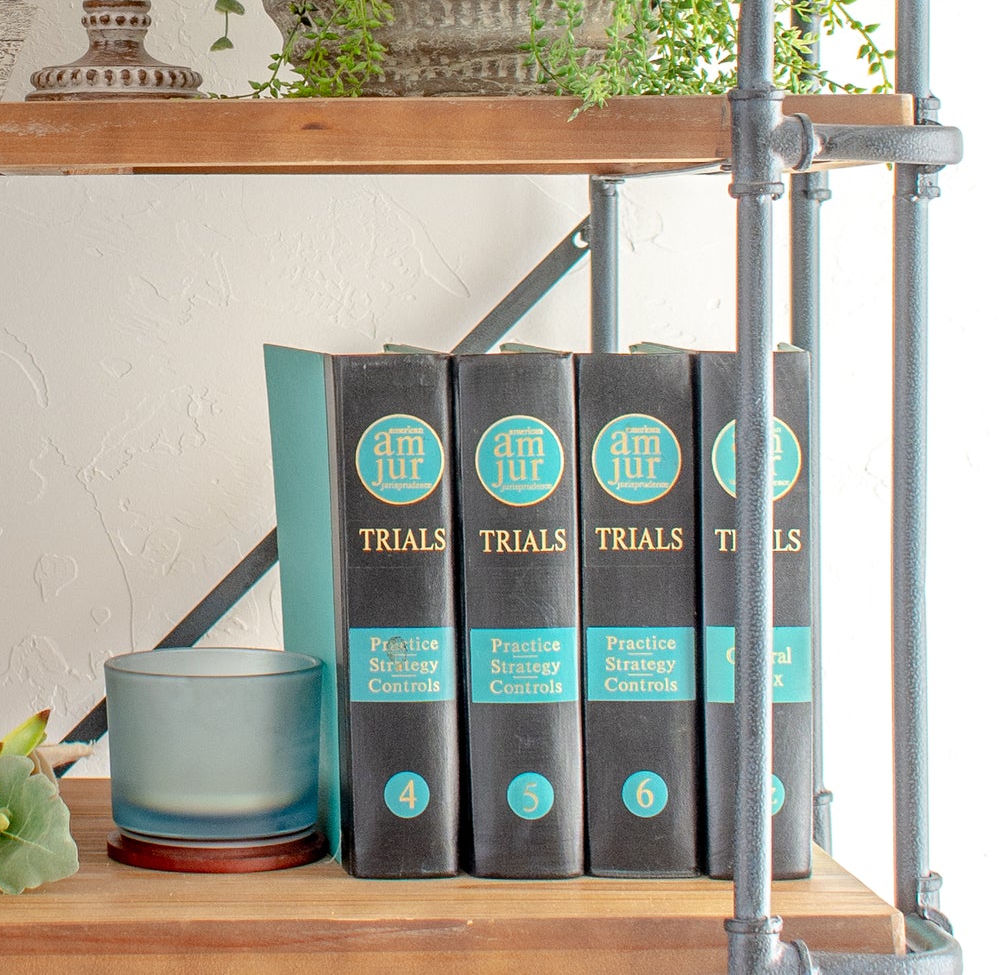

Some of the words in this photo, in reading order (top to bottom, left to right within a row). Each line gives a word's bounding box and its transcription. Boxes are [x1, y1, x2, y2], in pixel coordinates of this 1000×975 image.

[389, 425, 424, 434] american
[508, 426, 544, 435] american
[374, 431, 425, 456] am
[493, 432, 545, 457] am
[610, 431, 661, 456] am
[371, 457, 424, 486] jur
[491, 458, 544, 487] jur
[608, 456, 661, 485] jur
[380, 482, 432, 491] jurisprudence
[500, 483, 552, 492] jurisprudence
[616, 481, 669, 490] jurisprudence
[359, 528, 447, 552] TRIALS
[479, 529, 568, 553] TRIALS
[595, 527, 684, 551] TRIALS
[714, 528, 802, 552] TLS
[370, 636, 439, 652] Practice
[490, 638, 561, 654] Practice
[606, 636, 677, 650] Practice
[369, 657, 439, 674] Strategy
[490, 659, 561, 675] Strategy
[605, 657, 676, 673] Strategy
[368, 678, 441, 693] Controls
[489, 680, 563, 695] Controls
[604, 677, 678, 693] Controls
[399, 779, 417, 810] 4
[522, 782, 539, 813] 5
[636, 778, 654, 809] 6
